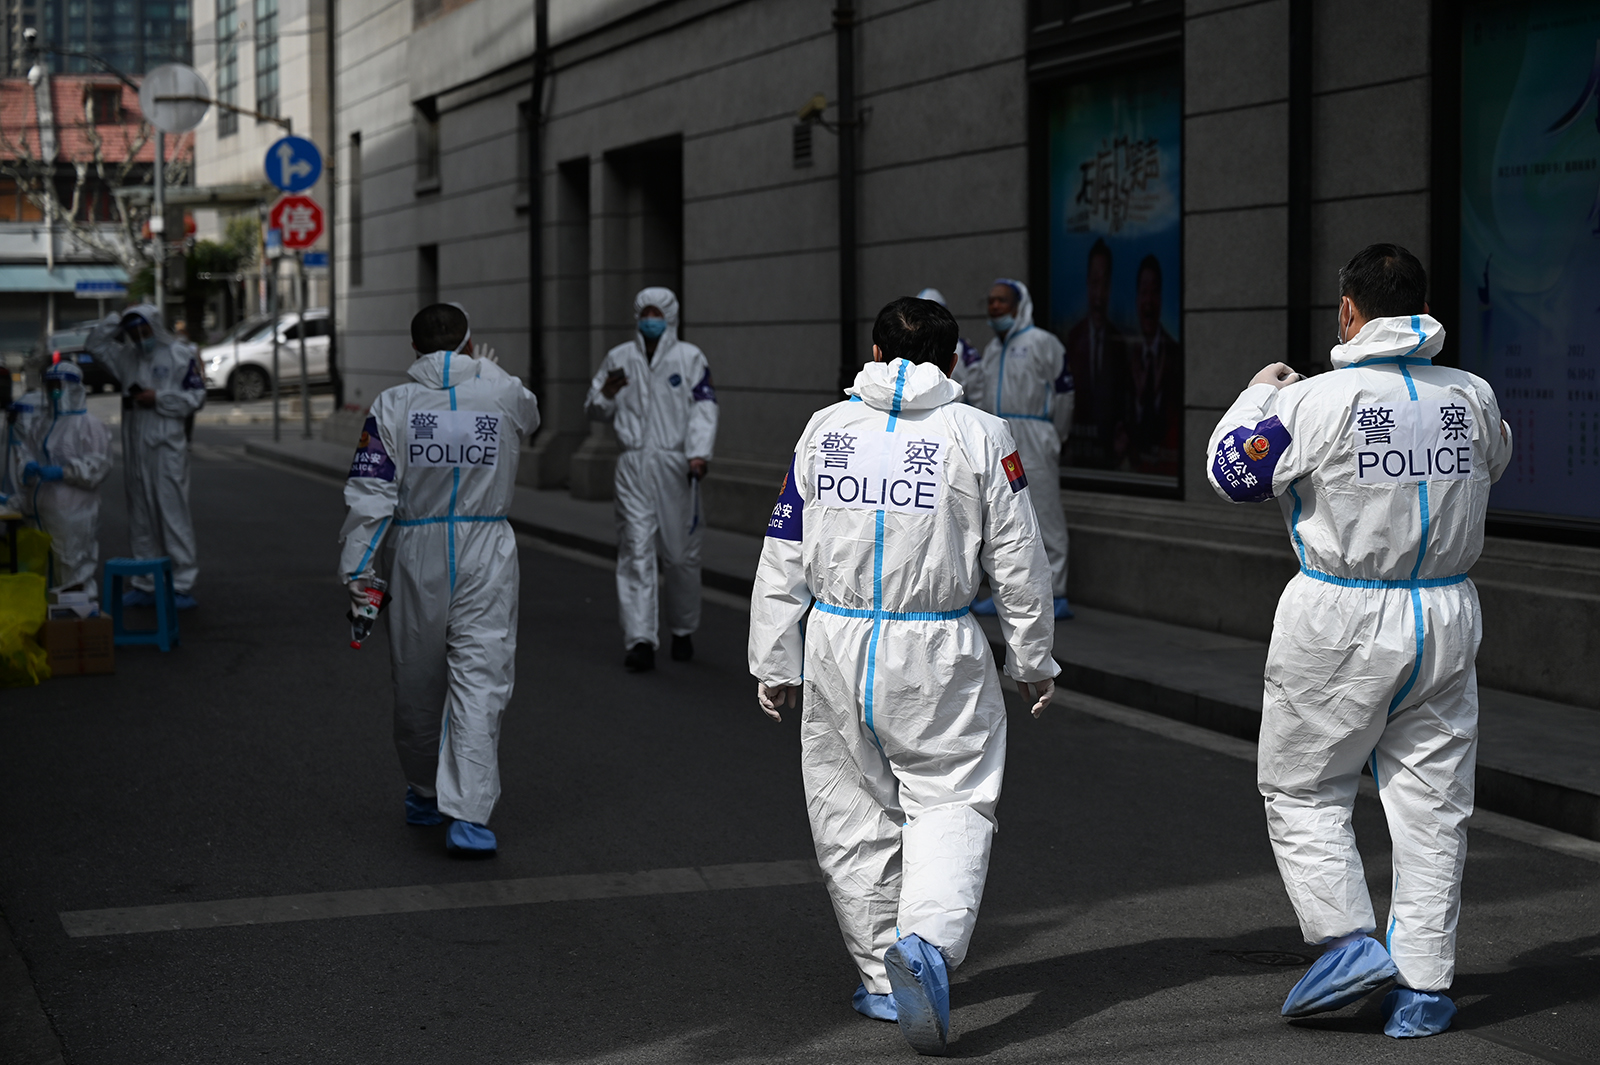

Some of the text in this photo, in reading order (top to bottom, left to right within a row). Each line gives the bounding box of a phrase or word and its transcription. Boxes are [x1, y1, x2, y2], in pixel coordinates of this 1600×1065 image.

[279, 203, 317, 242] 停
[410, 412, 499, 442] 警察
[1356, 402, 1469, 445] 警察
[409, 444, 497, 466] POLICE
[820, 431, 941, 476] 警察
[1216, 449, 1240, 488] POLICE
[1223, 435, 1258, 488] 黄浦公安
[1358, 447, 1471, 479] POLICE
[816, 475, 937, 509] POLICE
